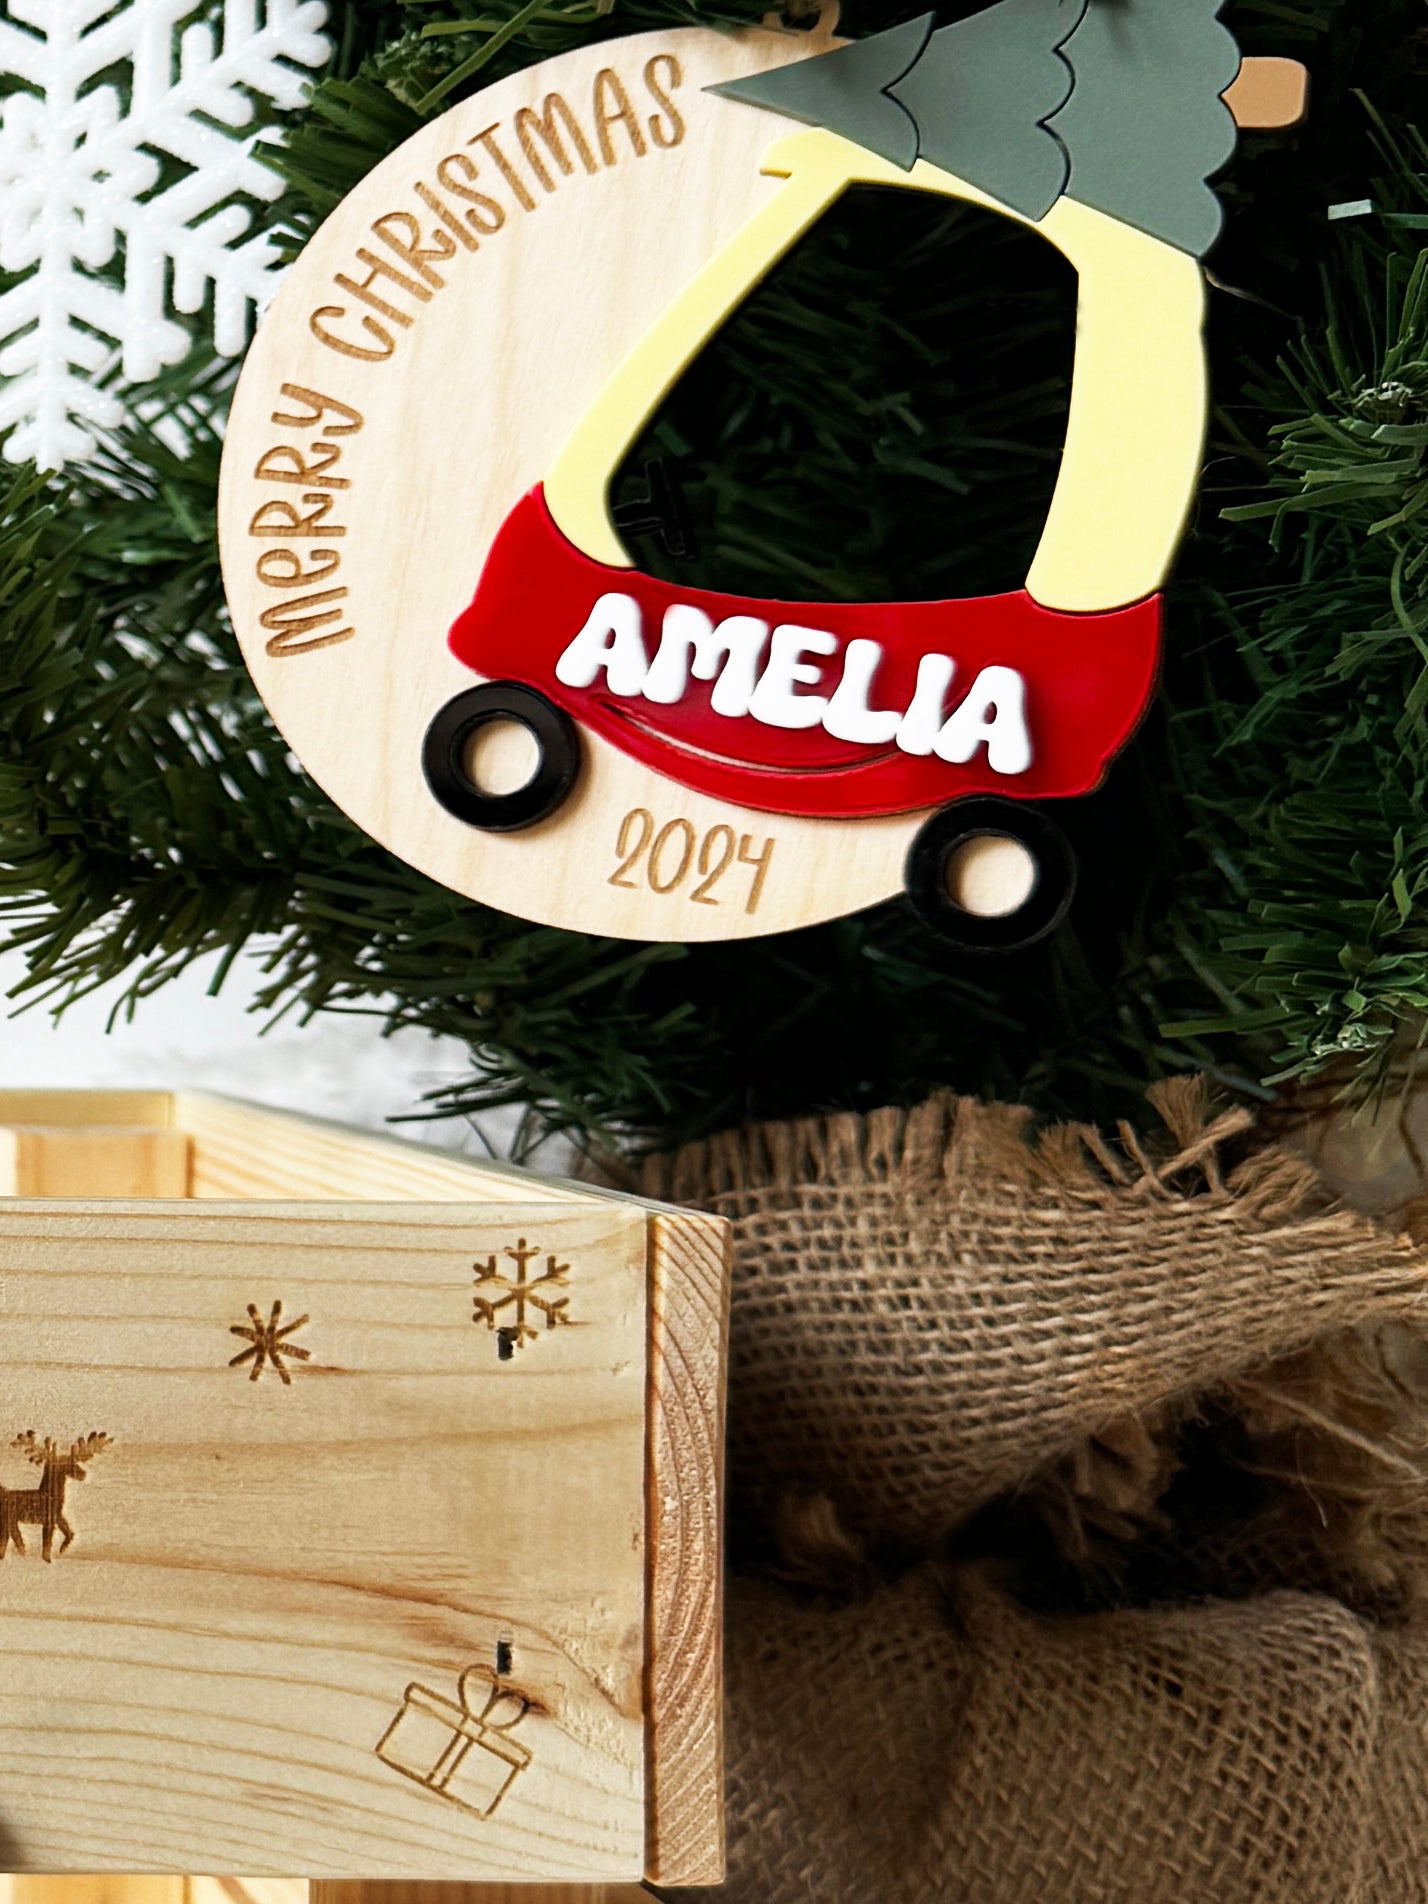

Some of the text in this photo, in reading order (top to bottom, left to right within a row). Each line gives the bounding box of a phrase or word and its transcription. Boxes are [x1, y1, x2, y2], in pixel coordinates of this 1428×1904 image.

[307, 53, 687, 364] CHRISTMAS
[554, 591, 1032, 776] AMELIA
[605, 806, 777, 916] 2024
